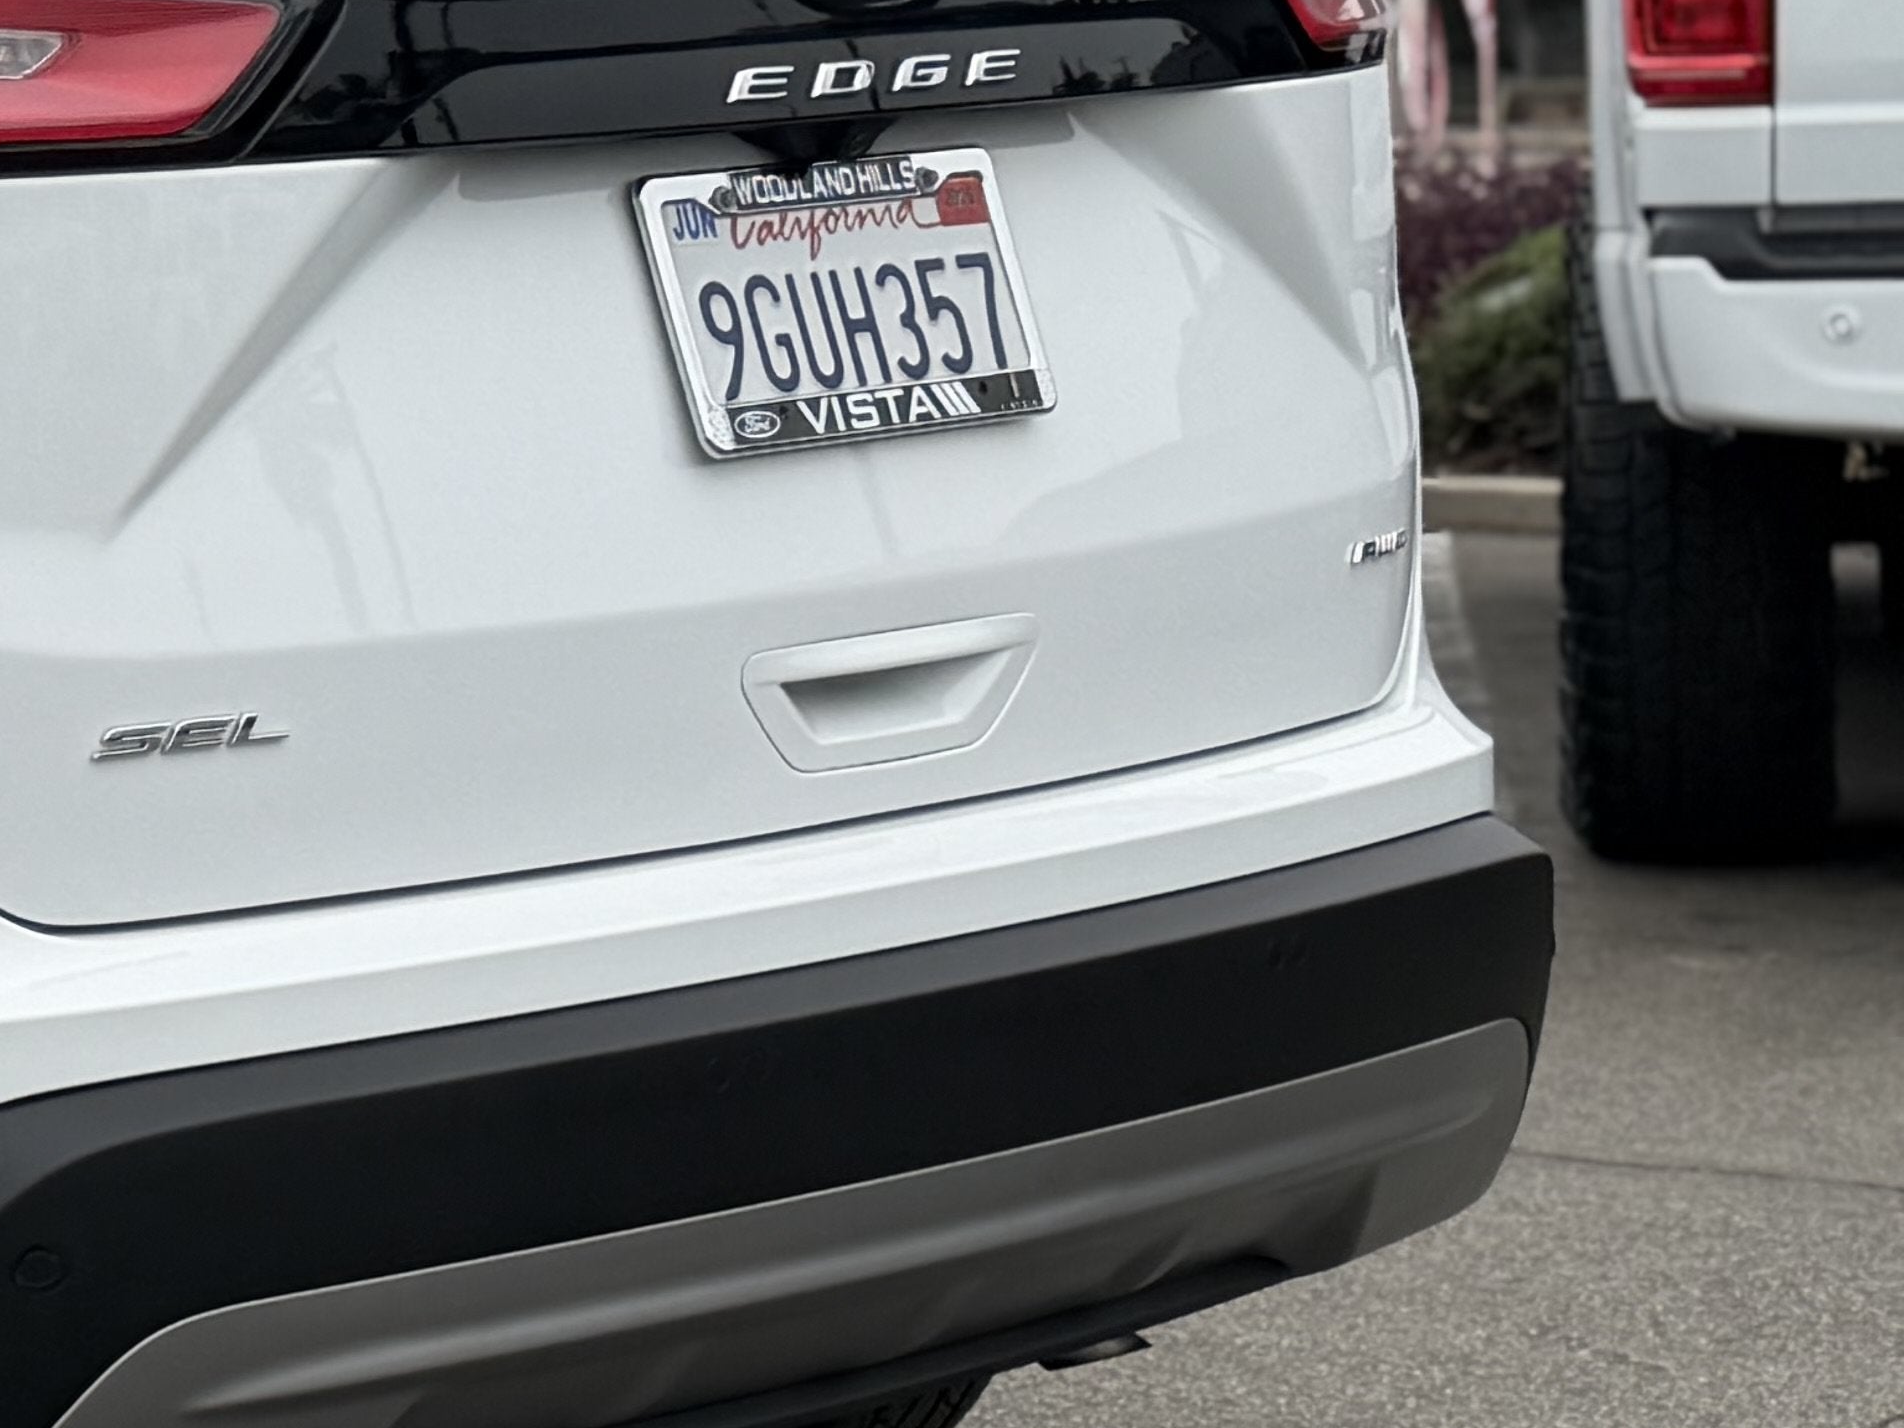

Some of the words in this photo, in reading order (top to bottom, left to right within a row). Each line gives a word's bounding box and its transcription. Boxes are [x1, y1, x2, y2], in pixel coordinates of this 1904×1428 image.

[726, 48, 1022, 104] EDGE
[857, 159, 916, 194] HILLS
[672, 199, 718, 242] JUN
[730, 199, 932, 261] California
[698, 251, 1008, 402] 9GUH357
[797, 383, 943, 435] VISTA
[90, 710, 290, 760] SEL
